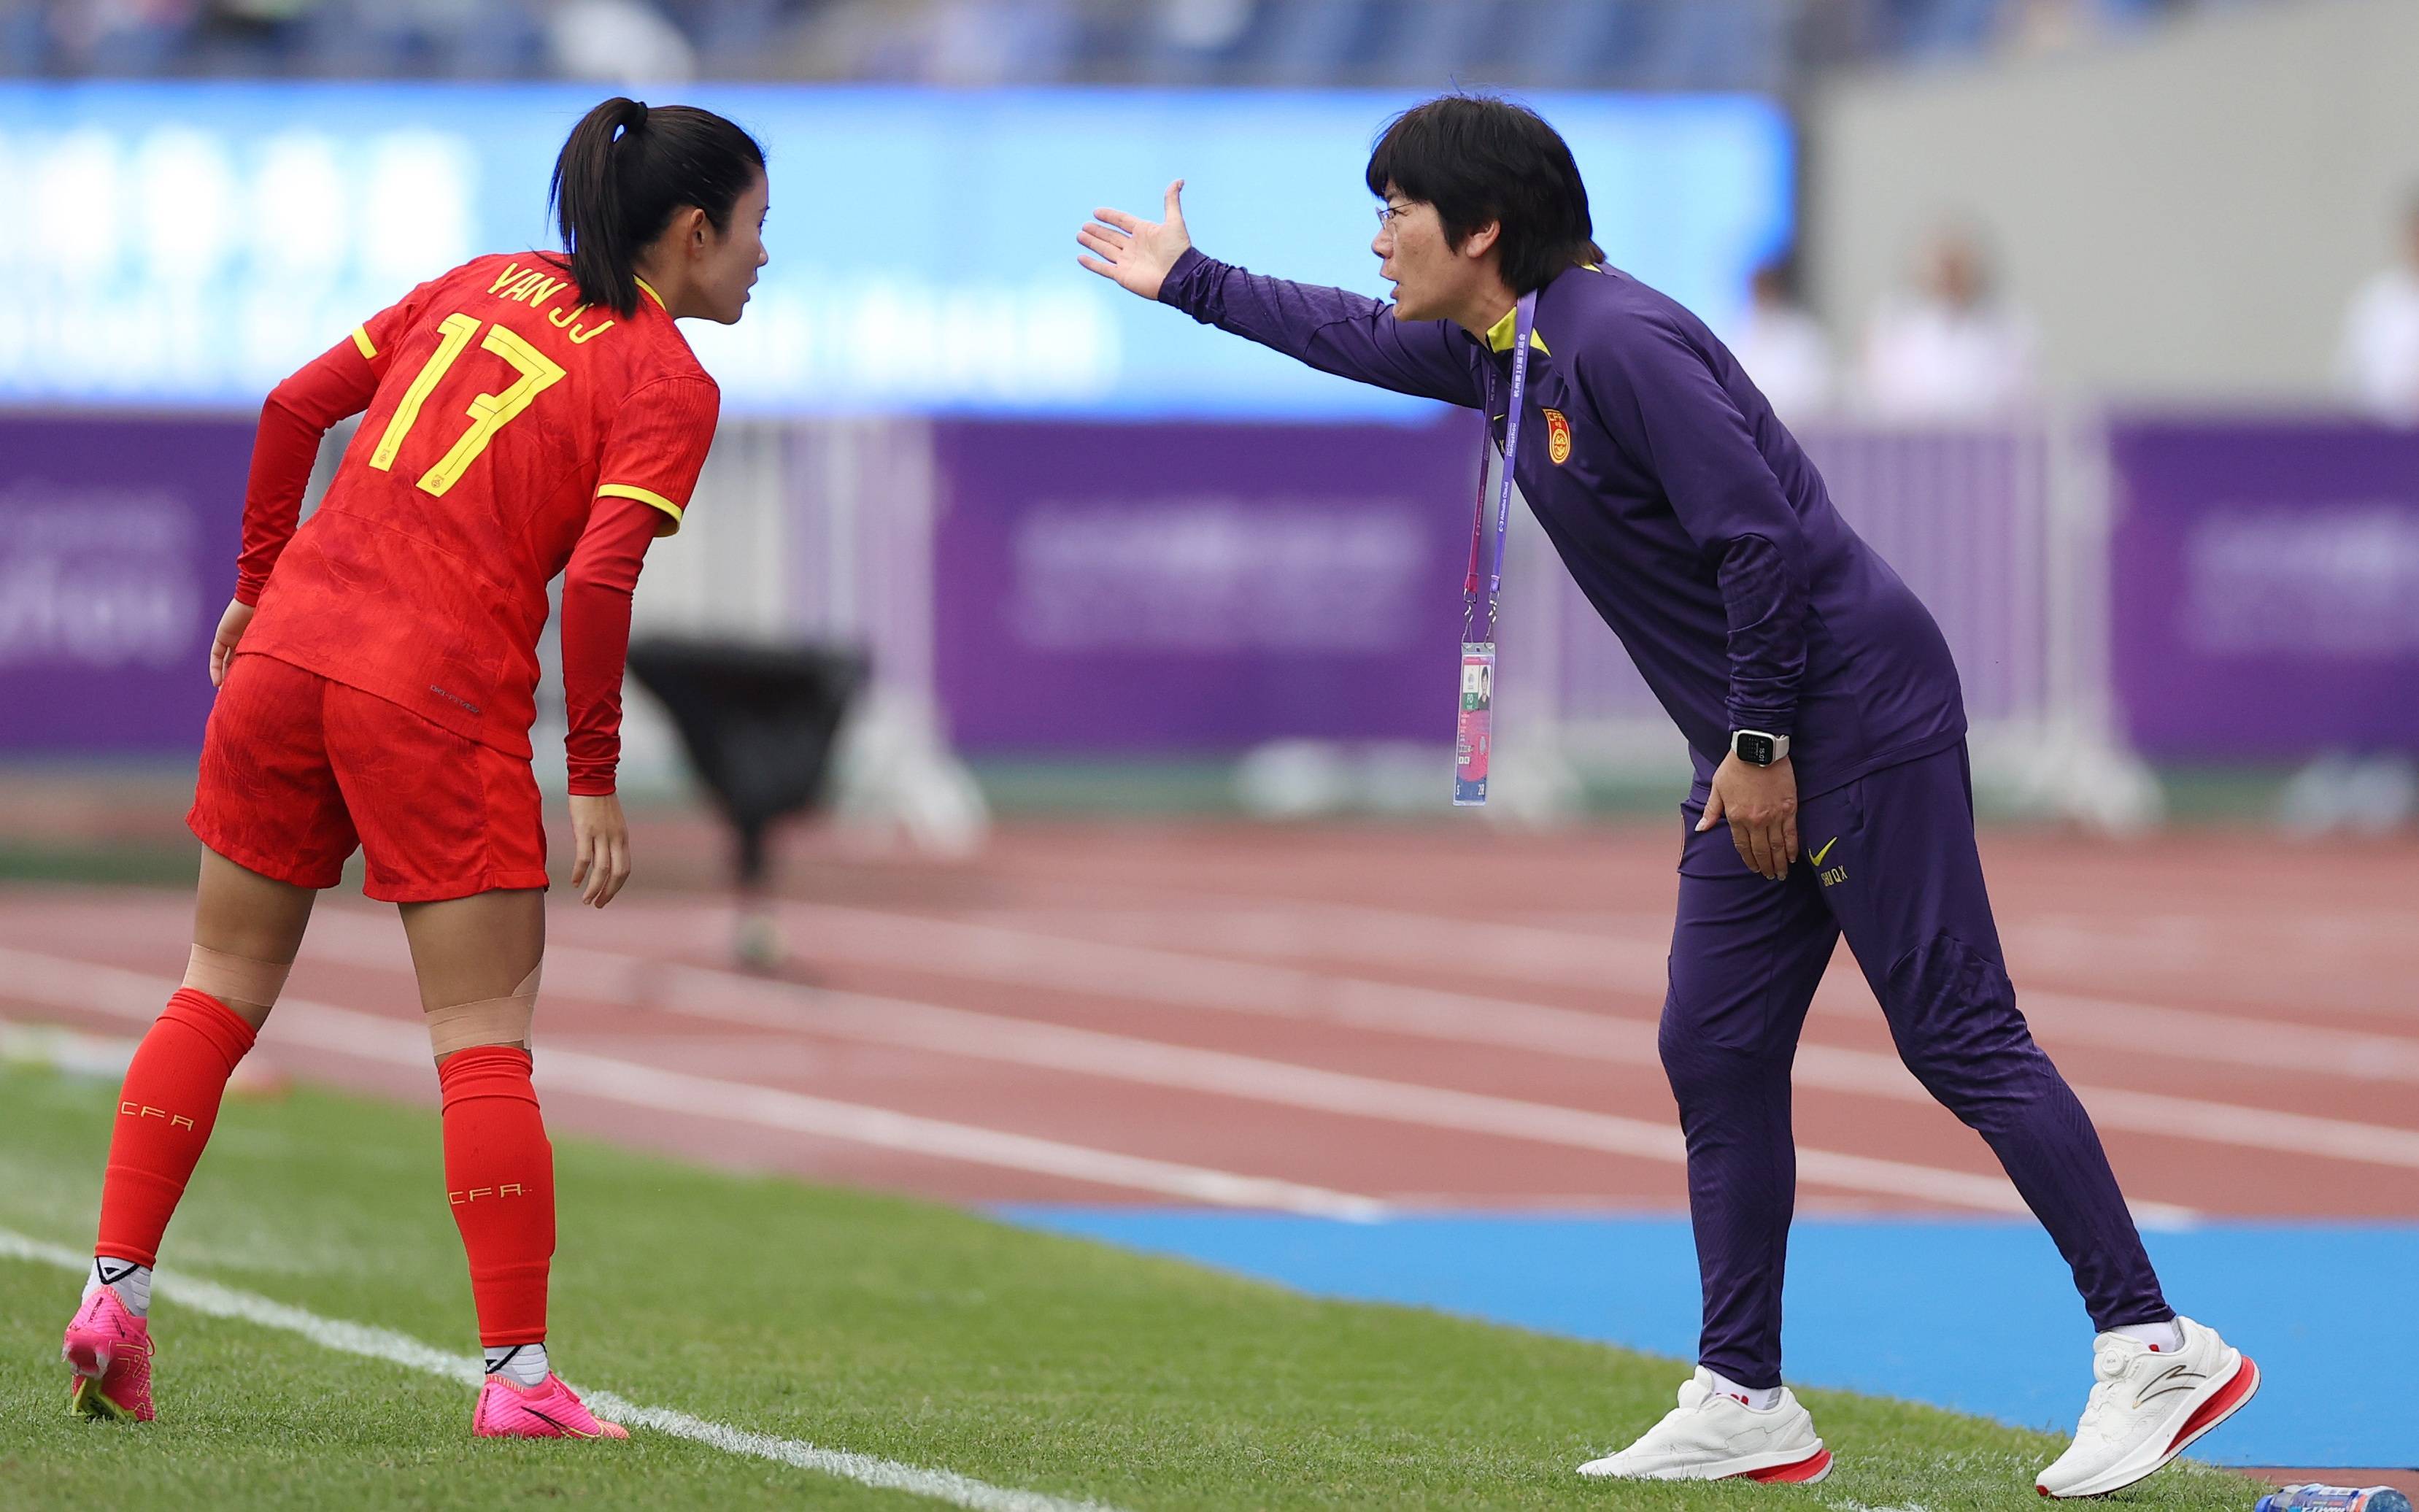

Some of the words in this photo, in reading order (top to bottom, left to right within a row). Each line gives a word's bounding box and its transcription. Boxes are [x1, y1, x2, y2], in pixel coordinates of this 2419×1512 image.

[486, 262, 568, 308] YAN
[547, 301, 615, 344] JJ
[368, 312, 568, 498] 17
[121, 1101, 194, 1132] CFA
[449, 1183, 522, 1205] CFA
